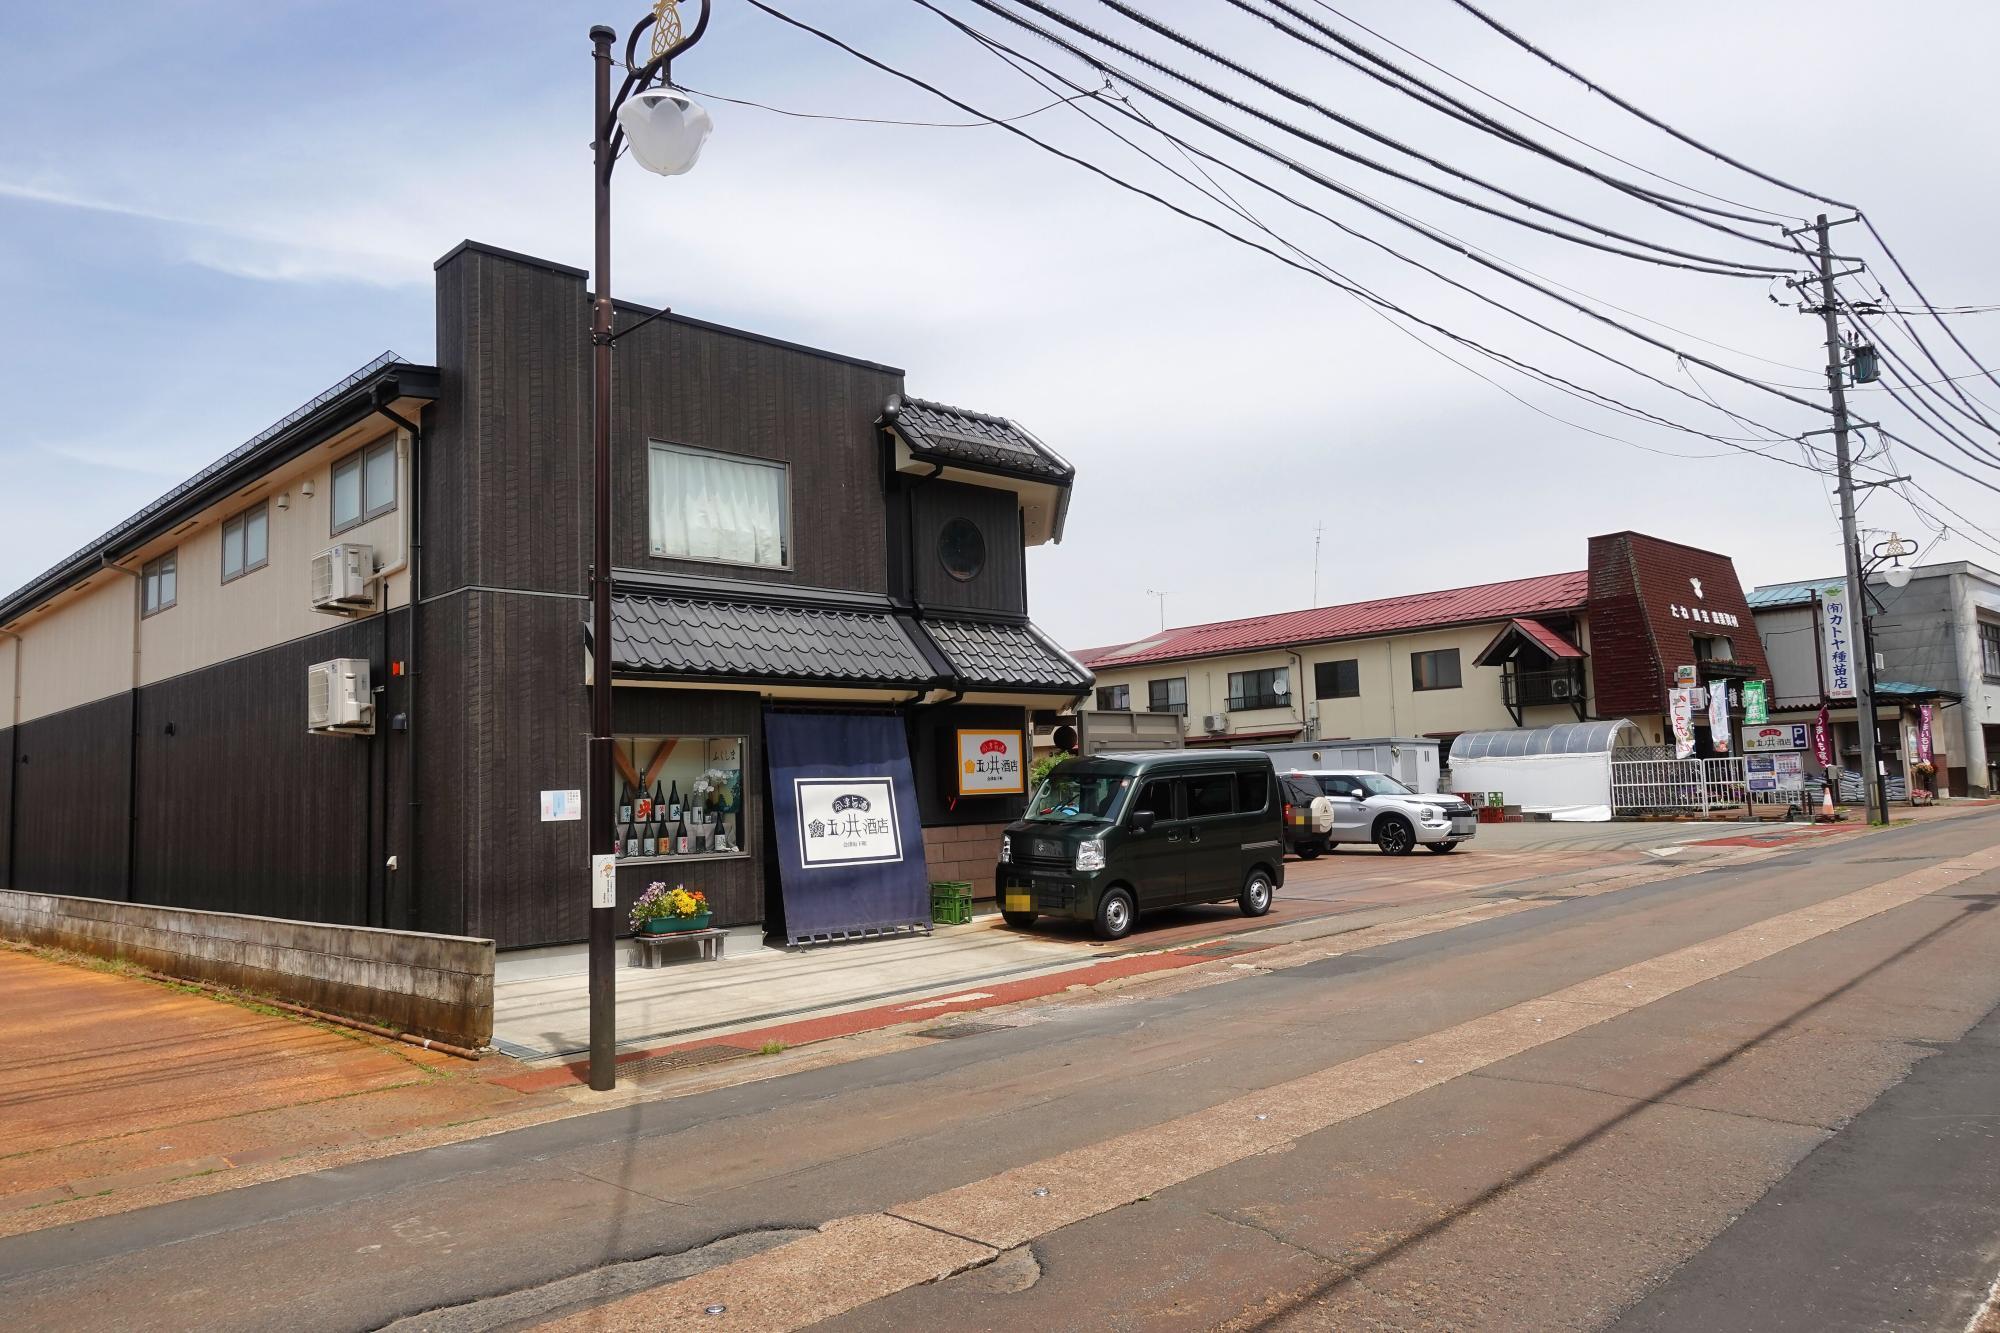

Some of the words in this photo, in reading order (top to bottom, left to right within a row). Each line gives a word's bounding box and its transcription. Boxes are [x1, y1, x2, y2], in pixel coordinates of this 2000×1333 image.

[1670, 604, 1689, 619] たね
[1826, 603, 1848, 688] (有)カトヤ種苗店
[1793, 728, 1803, 738] P
[976, 755, 1018, 775] 五ノ井酒店
[827, 813, 889, 839] 五ノ井酒店
